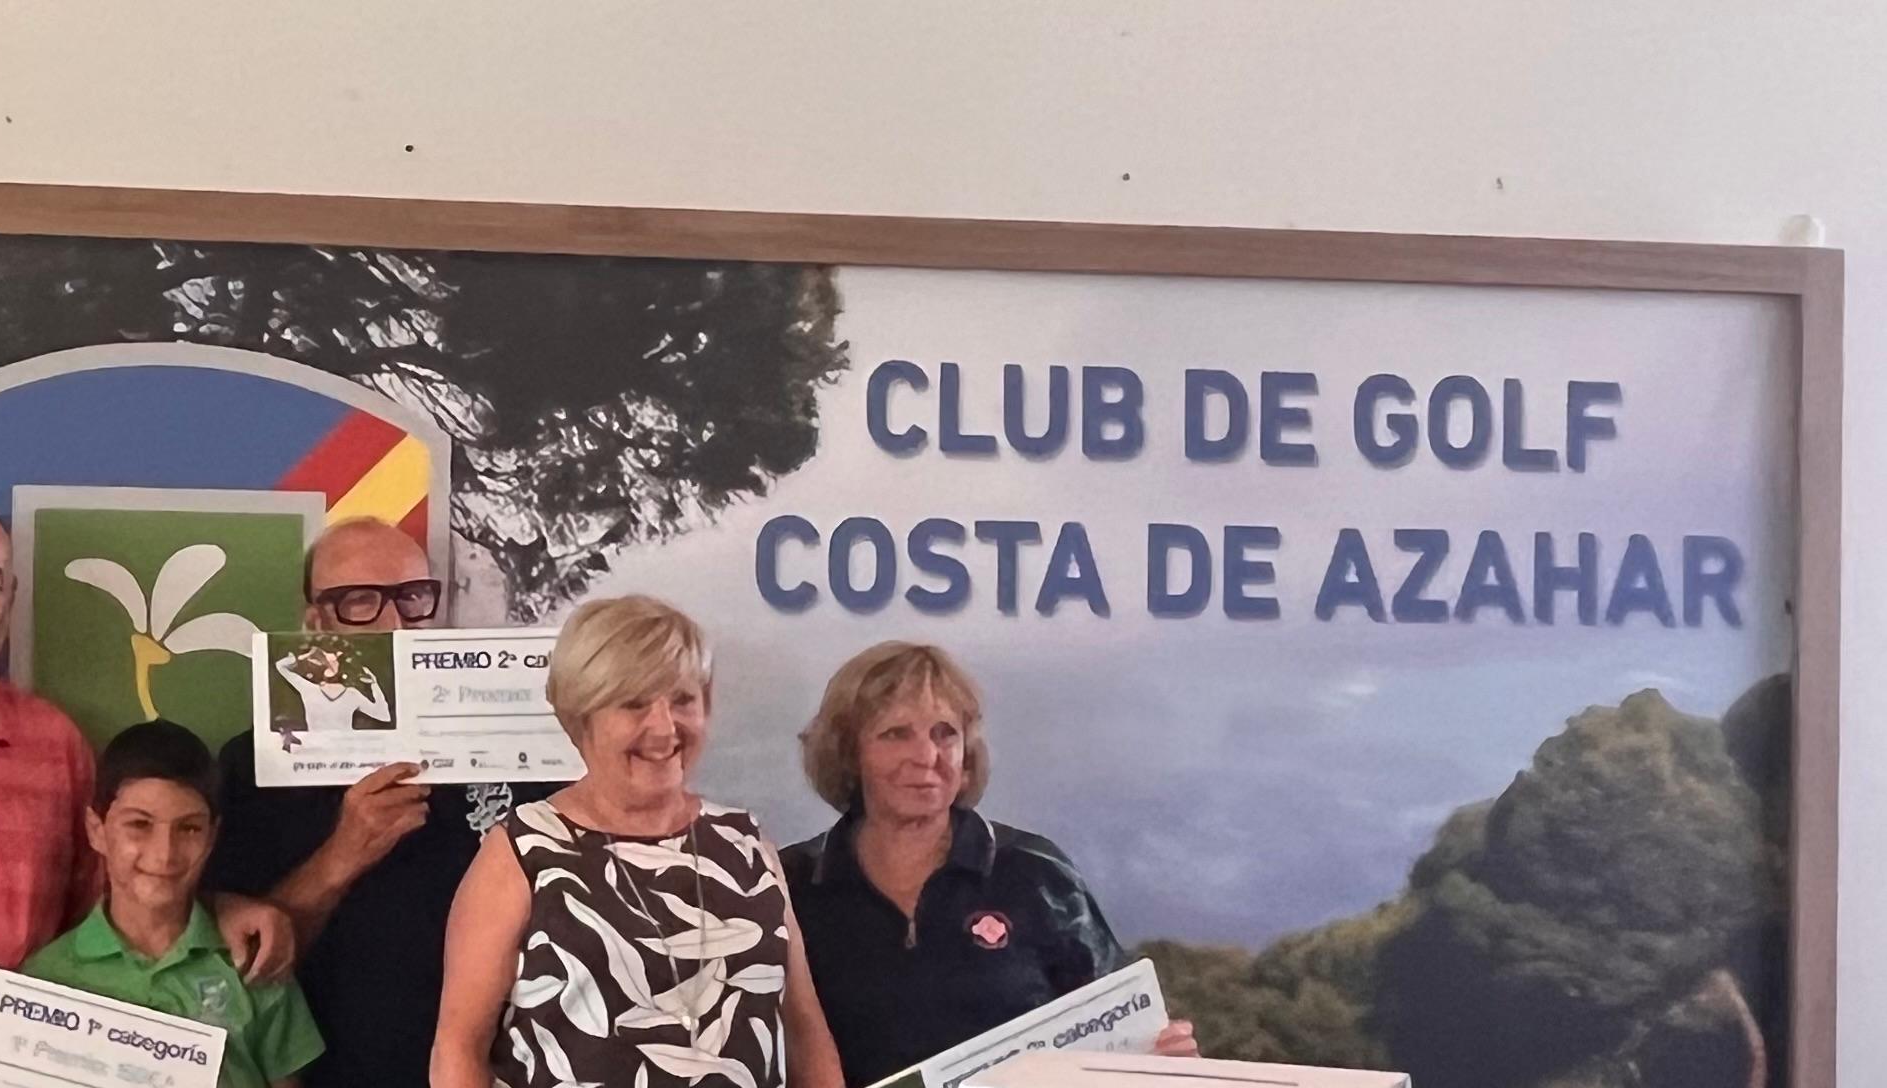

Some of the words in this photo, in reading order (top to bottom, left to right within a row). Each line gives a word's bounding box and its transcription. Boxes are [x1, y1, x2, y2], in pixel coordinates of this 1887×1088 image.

[867, 359, 1145, 463] CLUB
[1183, 367, 1319, 467] DE
[1352, 373, 1622, 473] GOLF
[755, 514, 1112, 619] COSTA
[1146, 523, 1282, 620] DE
[1314, 528, 1744, 629] AZAHAR
